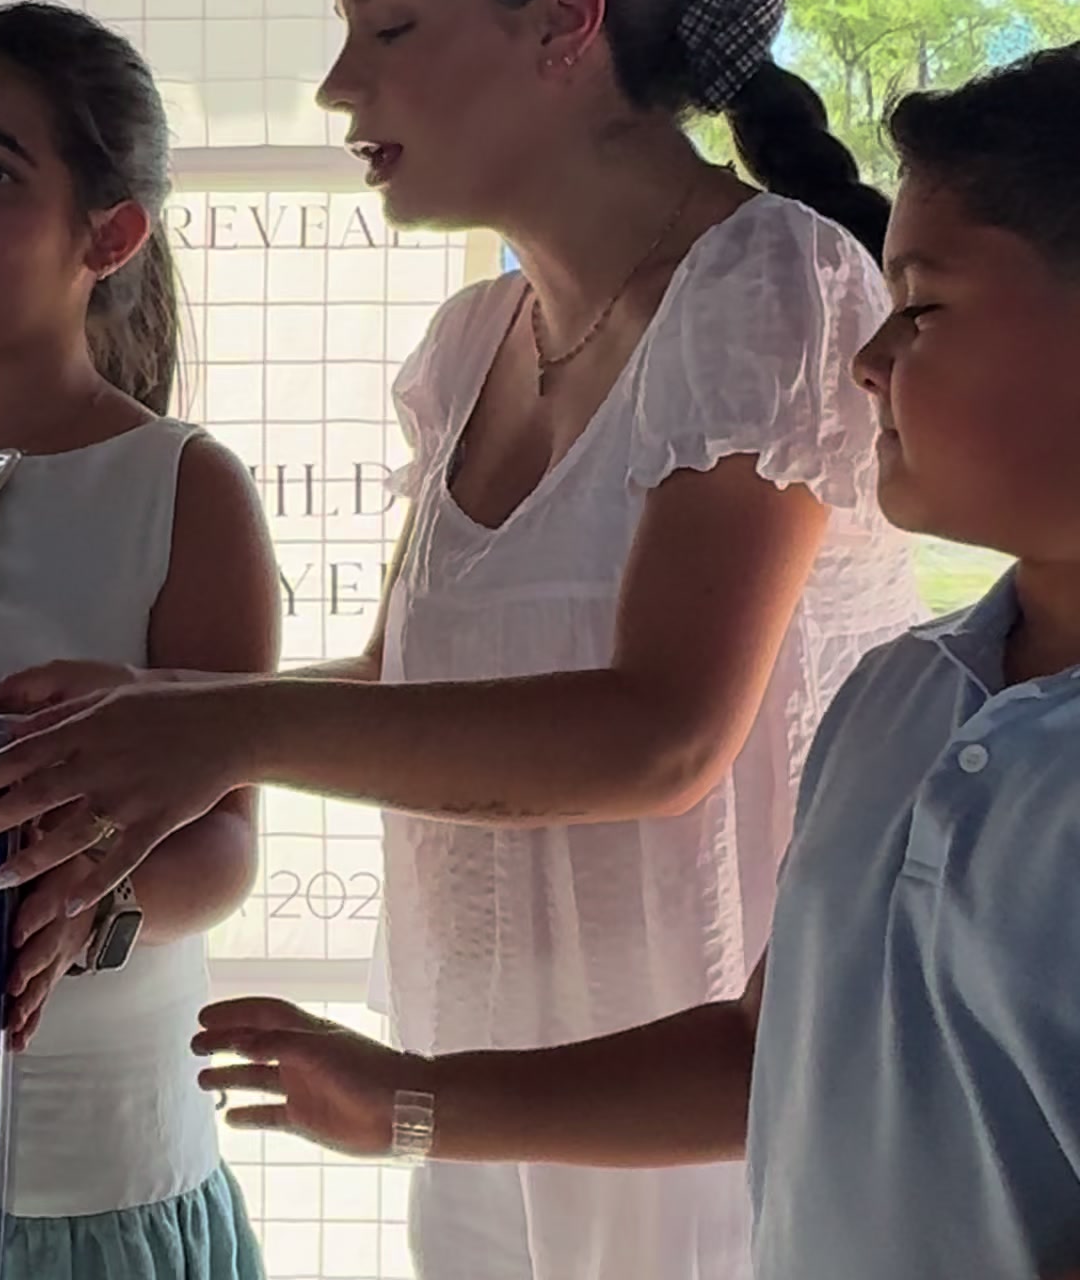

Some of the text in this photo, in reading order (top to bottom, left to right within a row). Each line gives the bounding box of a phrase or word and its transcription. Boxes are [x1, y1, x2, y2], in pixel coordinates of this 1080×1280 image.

[163, 205, 420, 249] REVEAL
[249, 462, 396, 517] ILD
[279, 562, 395, 616] YE
[270, 870, 381, 920] 202
